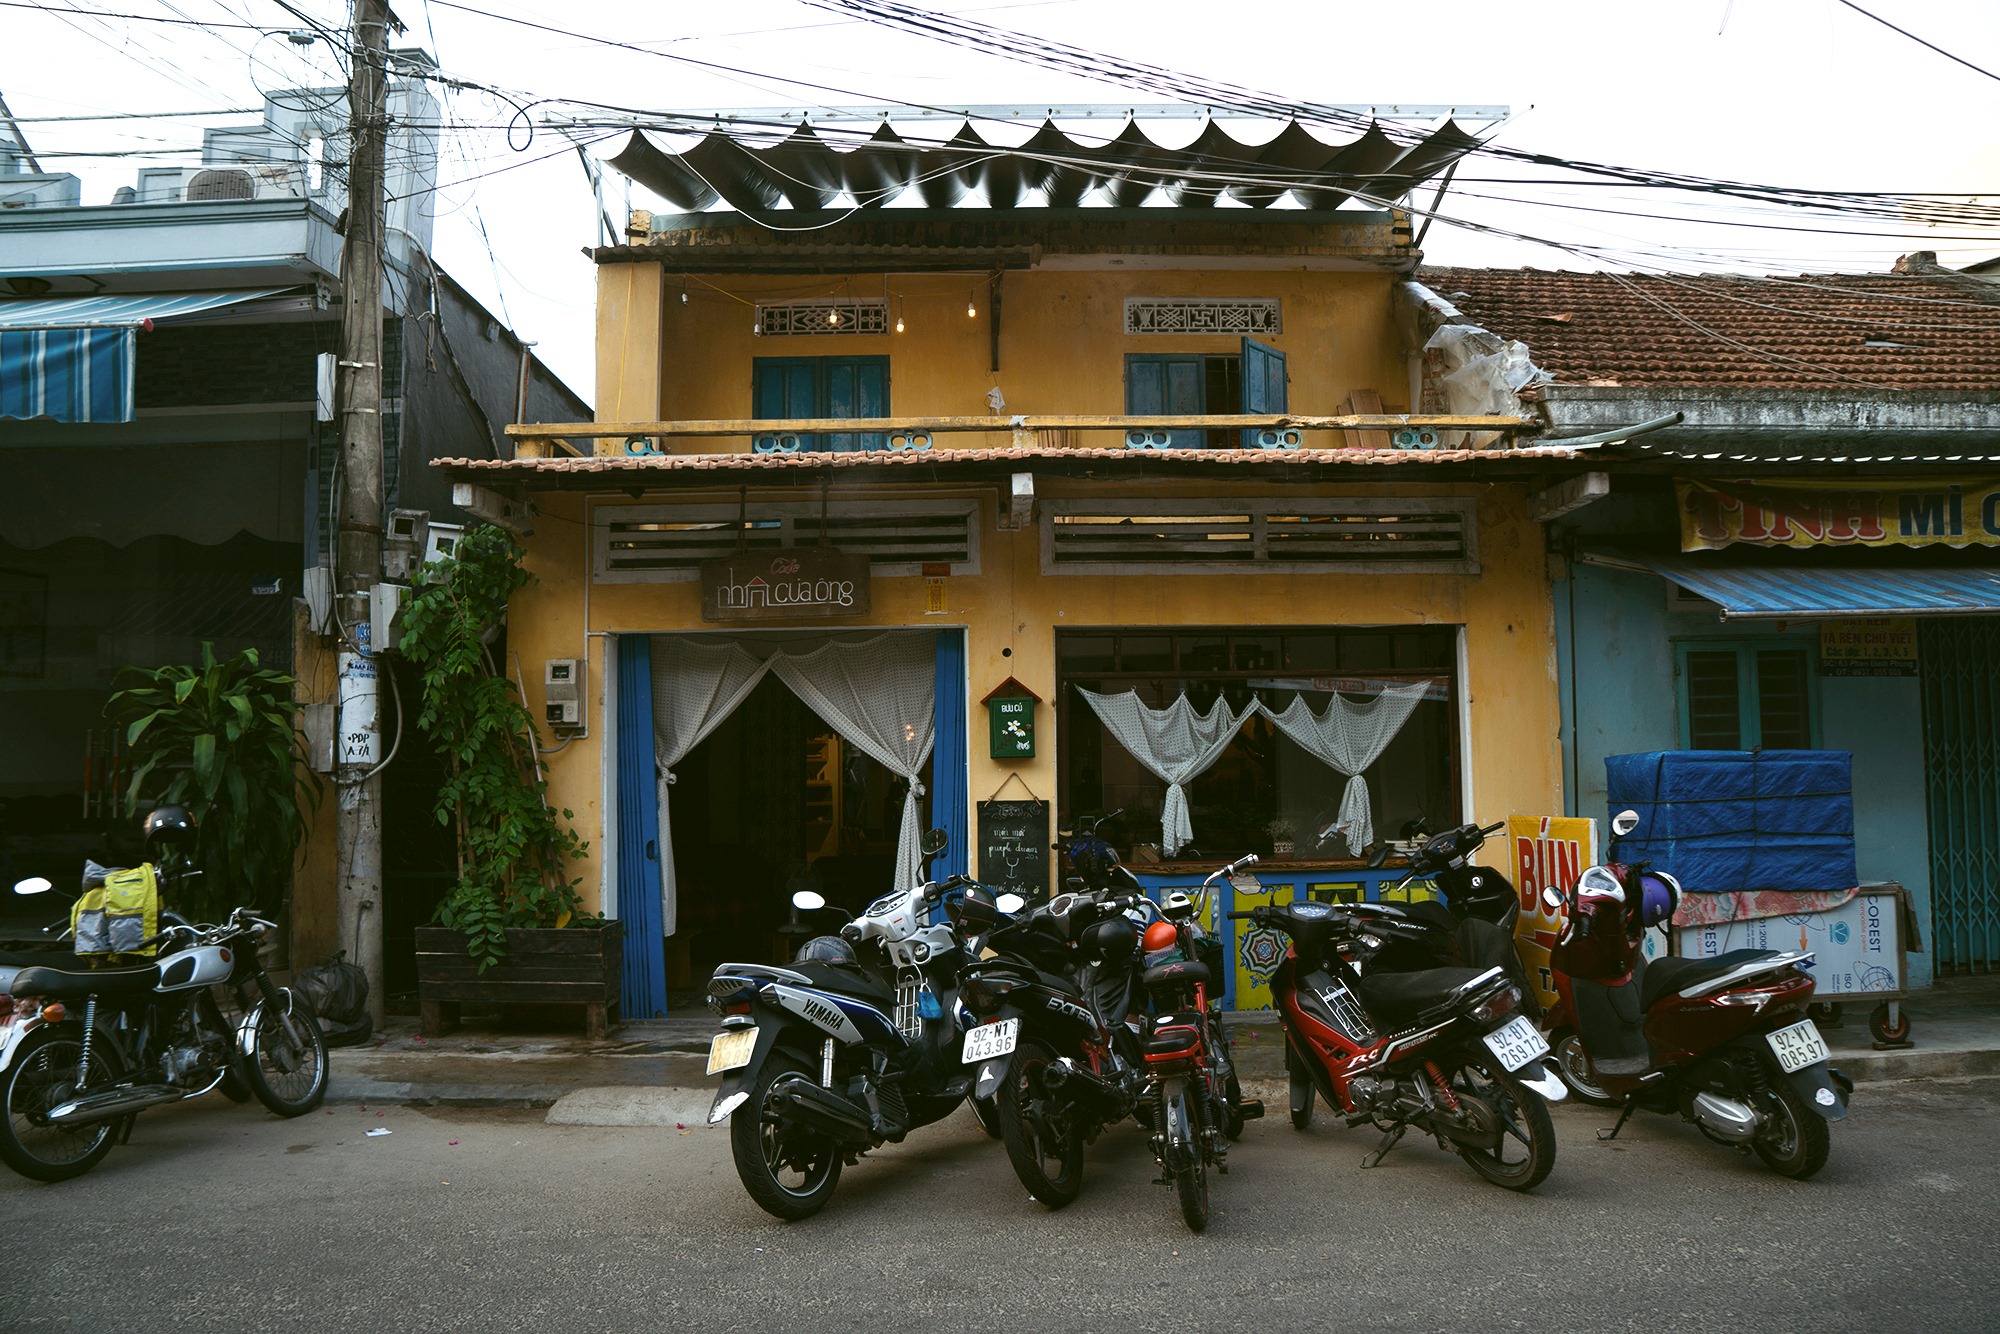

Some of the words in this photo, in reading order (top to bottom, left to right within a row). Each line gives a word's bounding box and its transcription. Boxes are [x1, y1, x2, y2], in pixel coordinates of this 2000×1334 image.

[1898, 483, 1964, 537] MÌ
[815, 577, 854, 606] ông
[1867, 894, 1881, 953] COREST
[1538, 966, 1558, 994] T
[802, 998, 845, 1031] YAMAHA
[973, 1022, 1008, 1044] 92-N1
[1492, 1022, 1528, 1049] 92-B1
[1775, 1025, 1812, 1050] 92-V1
[966, 1036, 1012, 1061] 043.96
[1501, 1035, 1545, 1068] 269.72
[1780, 1039, 1824, 1069] 085.97
